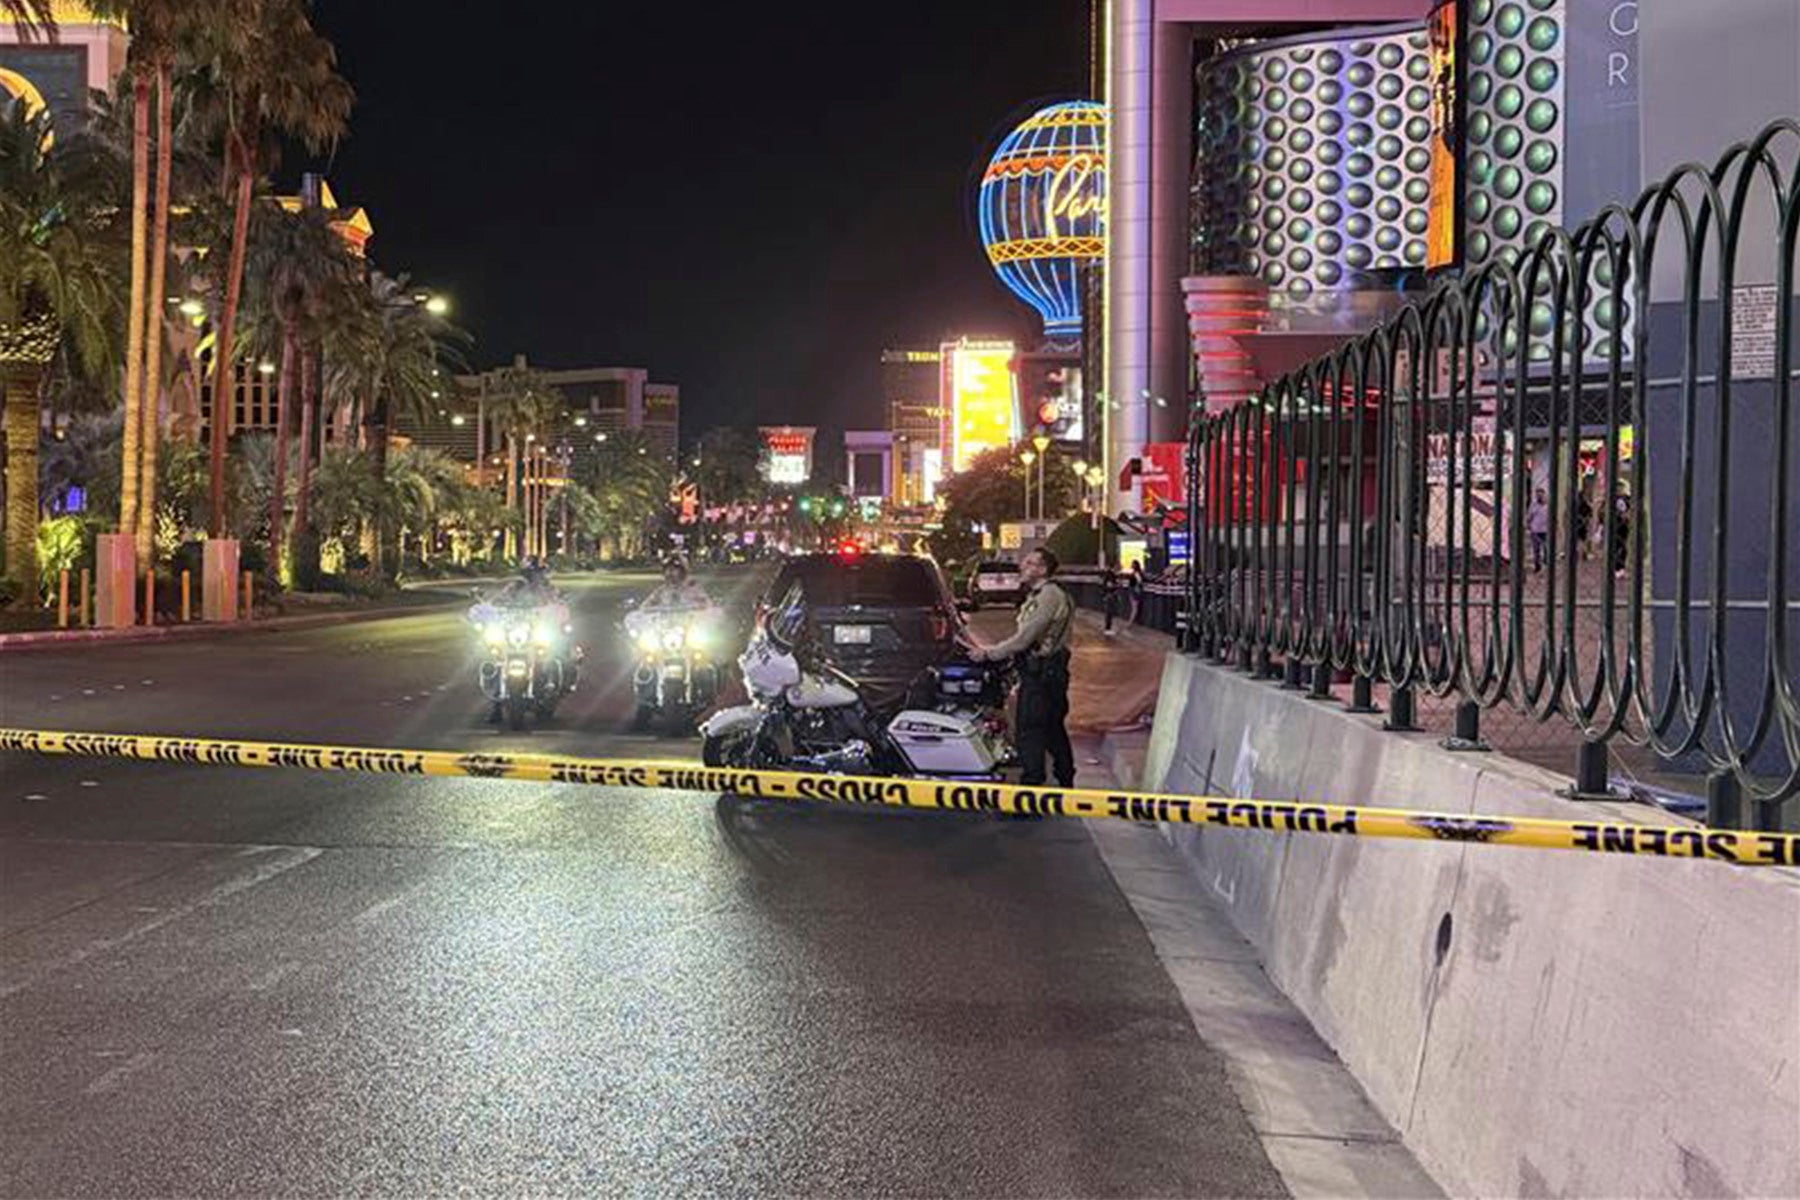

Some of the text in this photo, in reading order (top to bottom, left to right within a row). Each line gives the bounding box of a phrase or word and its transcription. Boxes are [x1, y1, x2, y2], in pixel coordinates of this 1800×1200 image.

[550, 763, 646, 788] SCENE
[657, 769, 762, 796] CRIME
[796, 778, 910, 806] CROSS
[934, 785, 1000, 811] NOT
[1013, 790, 1064, 815] DO
[1107, 795, 1192, 823] LINE
[1206, 801, 1358, 834] POLICE
[1572, 824, 1739, 862] SCENE
